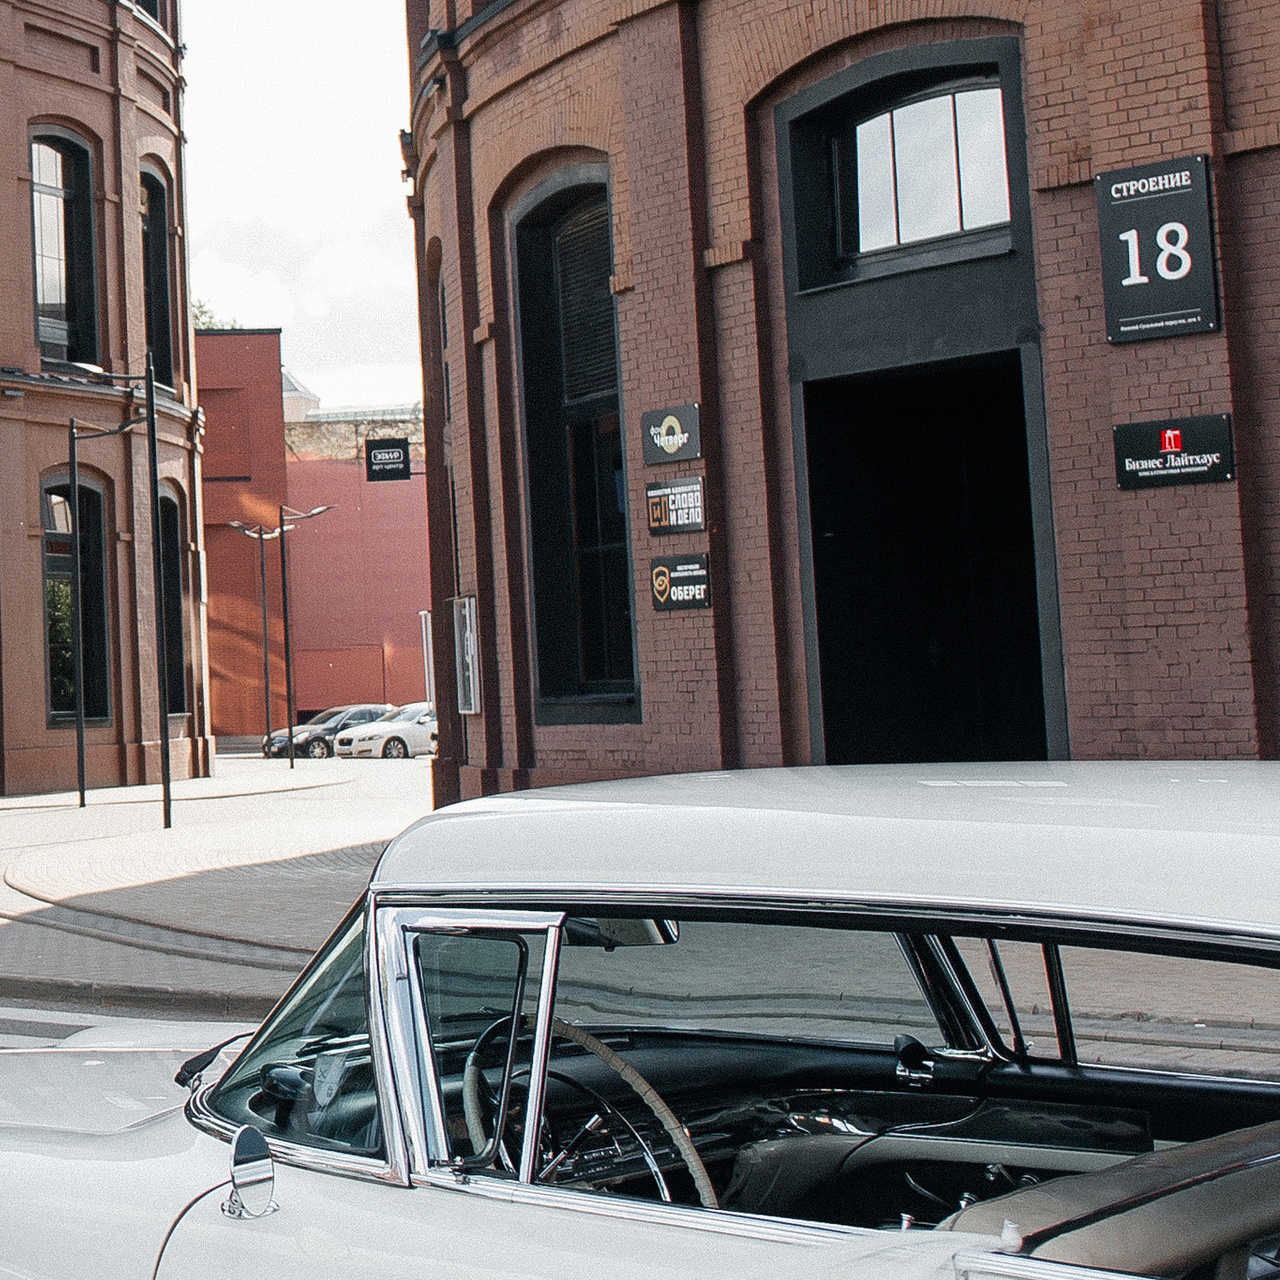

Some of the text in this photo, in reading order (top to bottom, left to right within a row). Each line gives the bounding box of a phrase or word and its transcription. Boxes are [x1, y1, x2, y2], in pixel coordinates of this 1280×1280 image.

[1111, 171, 1192, 198] СТРОЕНИЕ
[1119, 222, 1192, 286] 18
[1125, 452, 1221, 471] Бизнес Лайтхаус
[668, 491, 701, 510] СЛОВО
[669, 507, 702, 526] И ДЕЛО
[670, 584, 707, 601] ОБЕРЕГ
